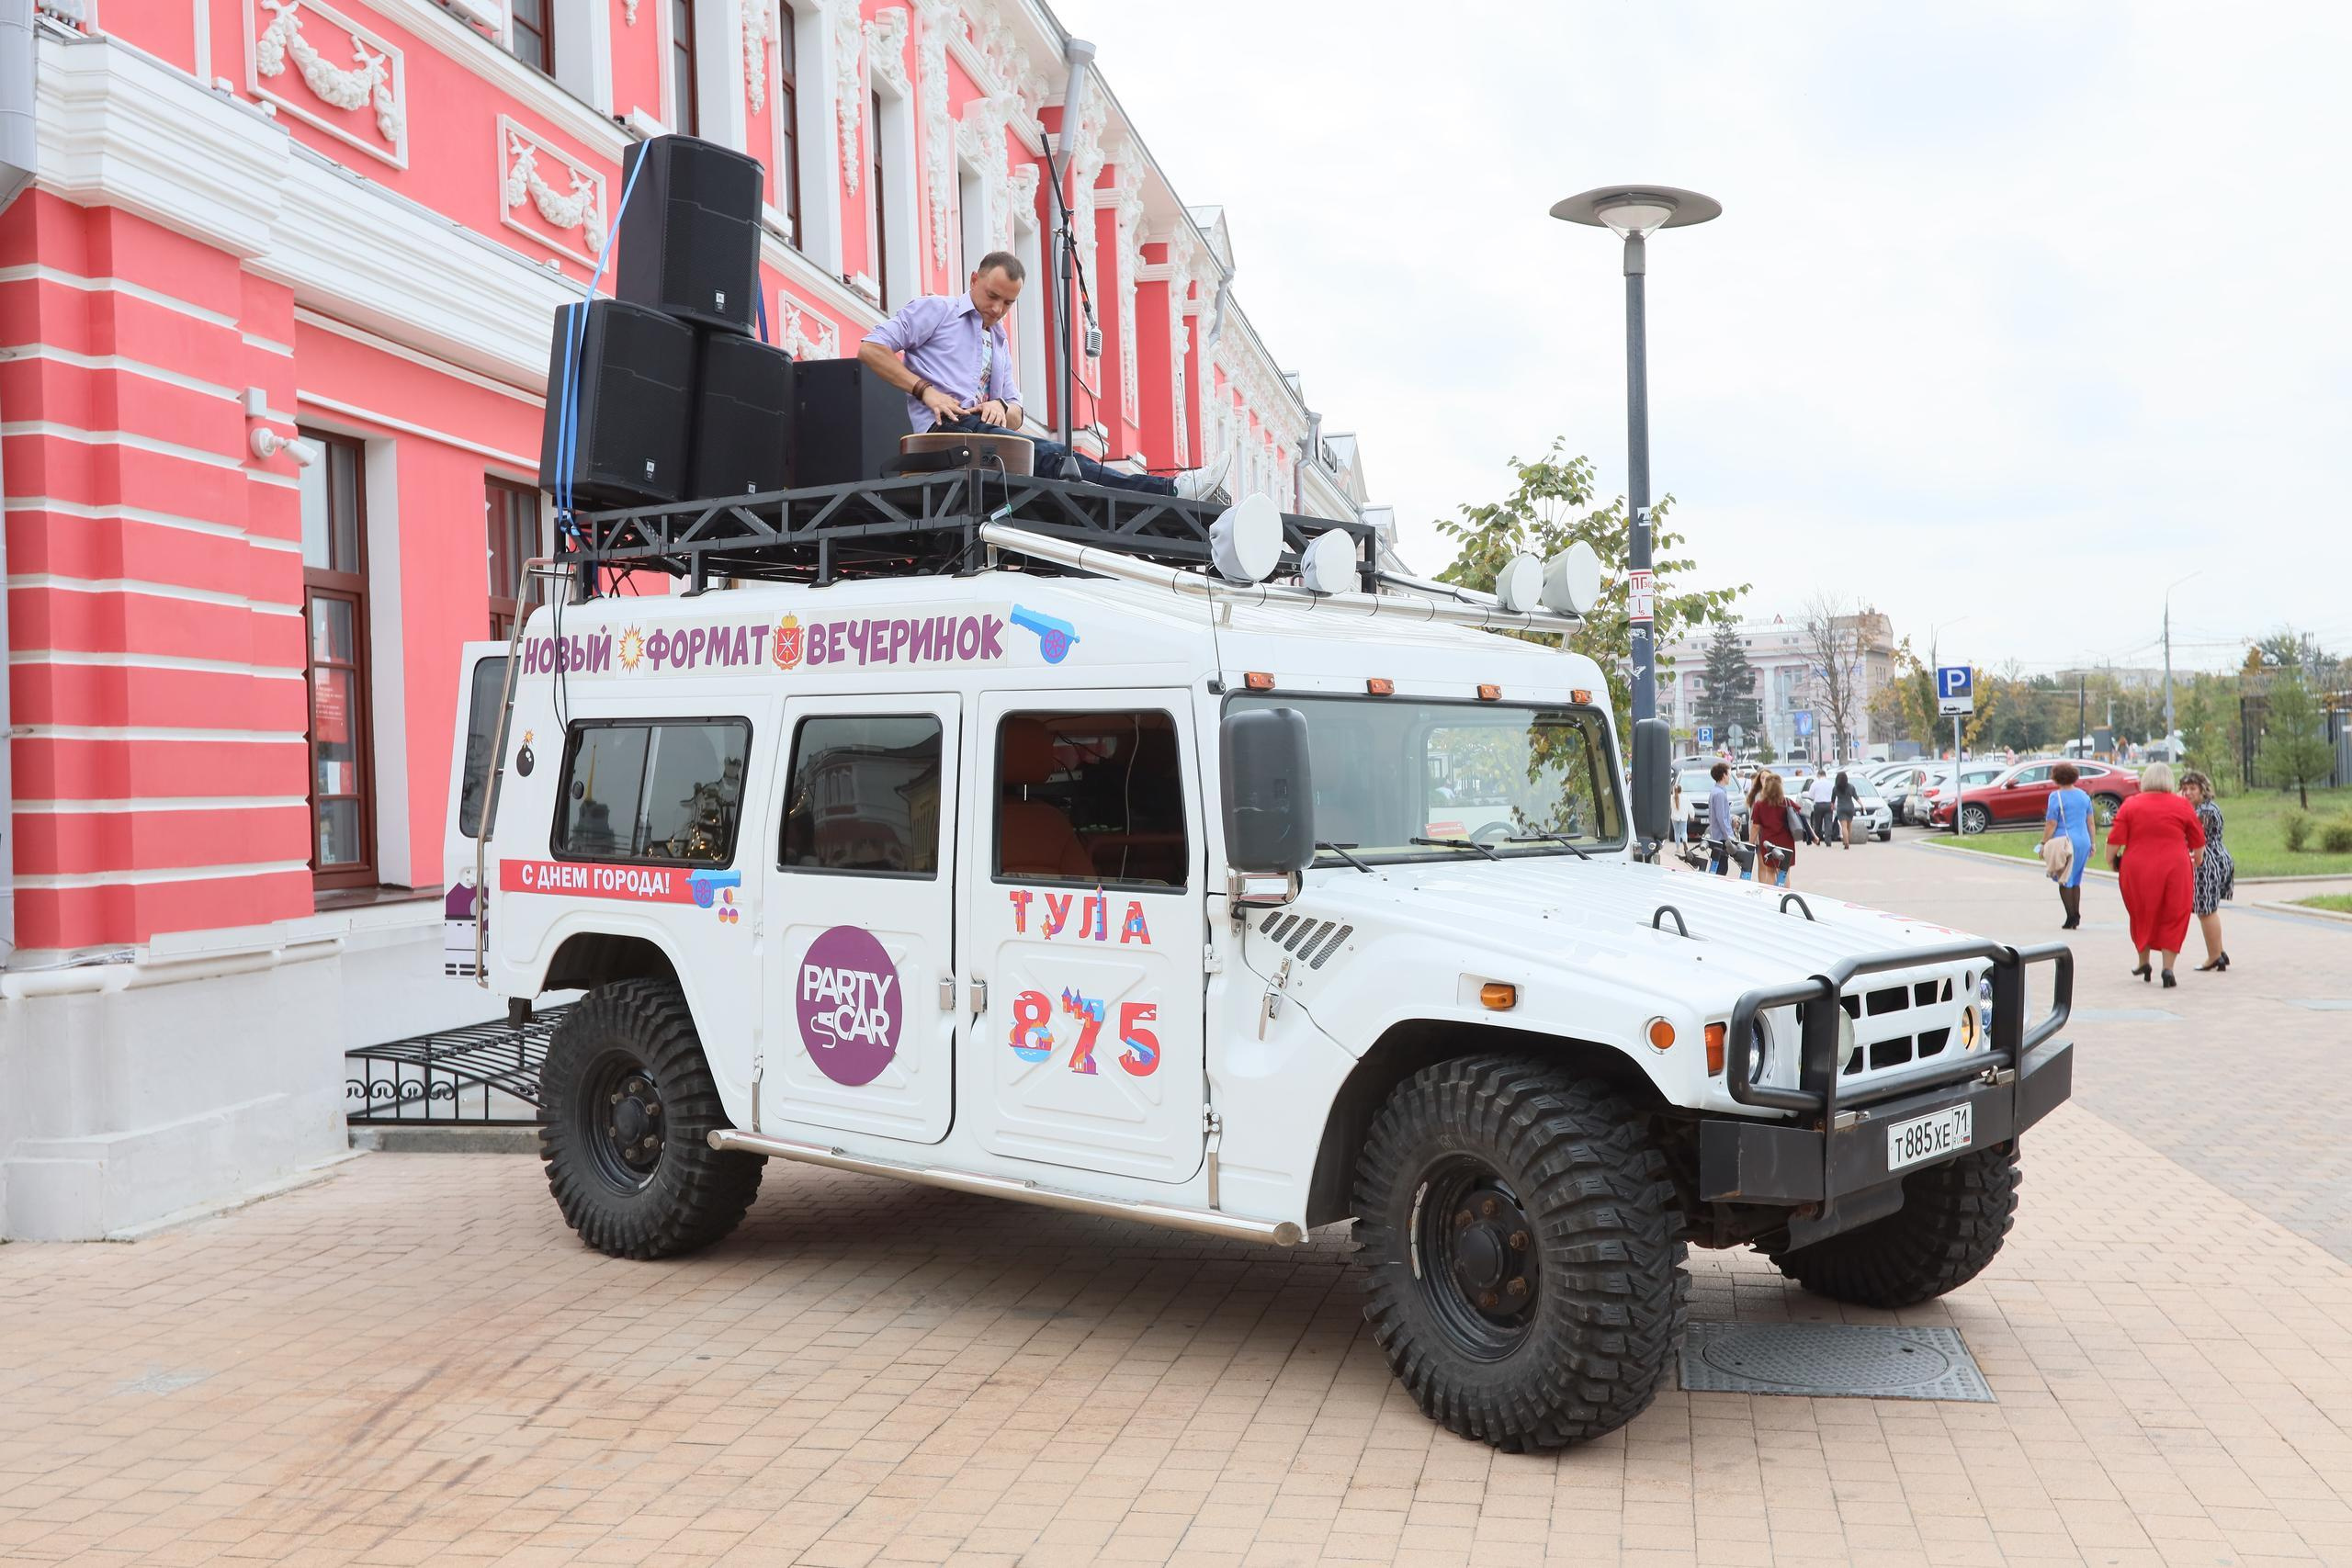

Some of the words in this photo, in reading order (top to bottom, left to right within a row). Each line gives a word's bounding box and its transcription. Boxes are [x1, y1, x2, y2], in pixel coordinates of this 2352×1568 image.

[523, 625, 611, 674] НОВЫЙ
[646, 625, 770, 671] ФОРМАТ
[807, 614, 1004, 666] ВЕЧЕРИНОК
[1947, 670, 1965, 695] P
[1702, 728, 1710, 740] P
[522, 864, 533, 885] С
[537, 865, 588, 889] ДНЕМ
[594, 868, 670, 897] ГОРОДА!
[1010, 885, 1151, 944] ТУЛА
[803, 964, 893, 1009] PARTY
[834, 1005, 890, 1047] CAR
[1009, 987, 1160, 1077] 875
[1954, 1109, 1967, 1134] 71
